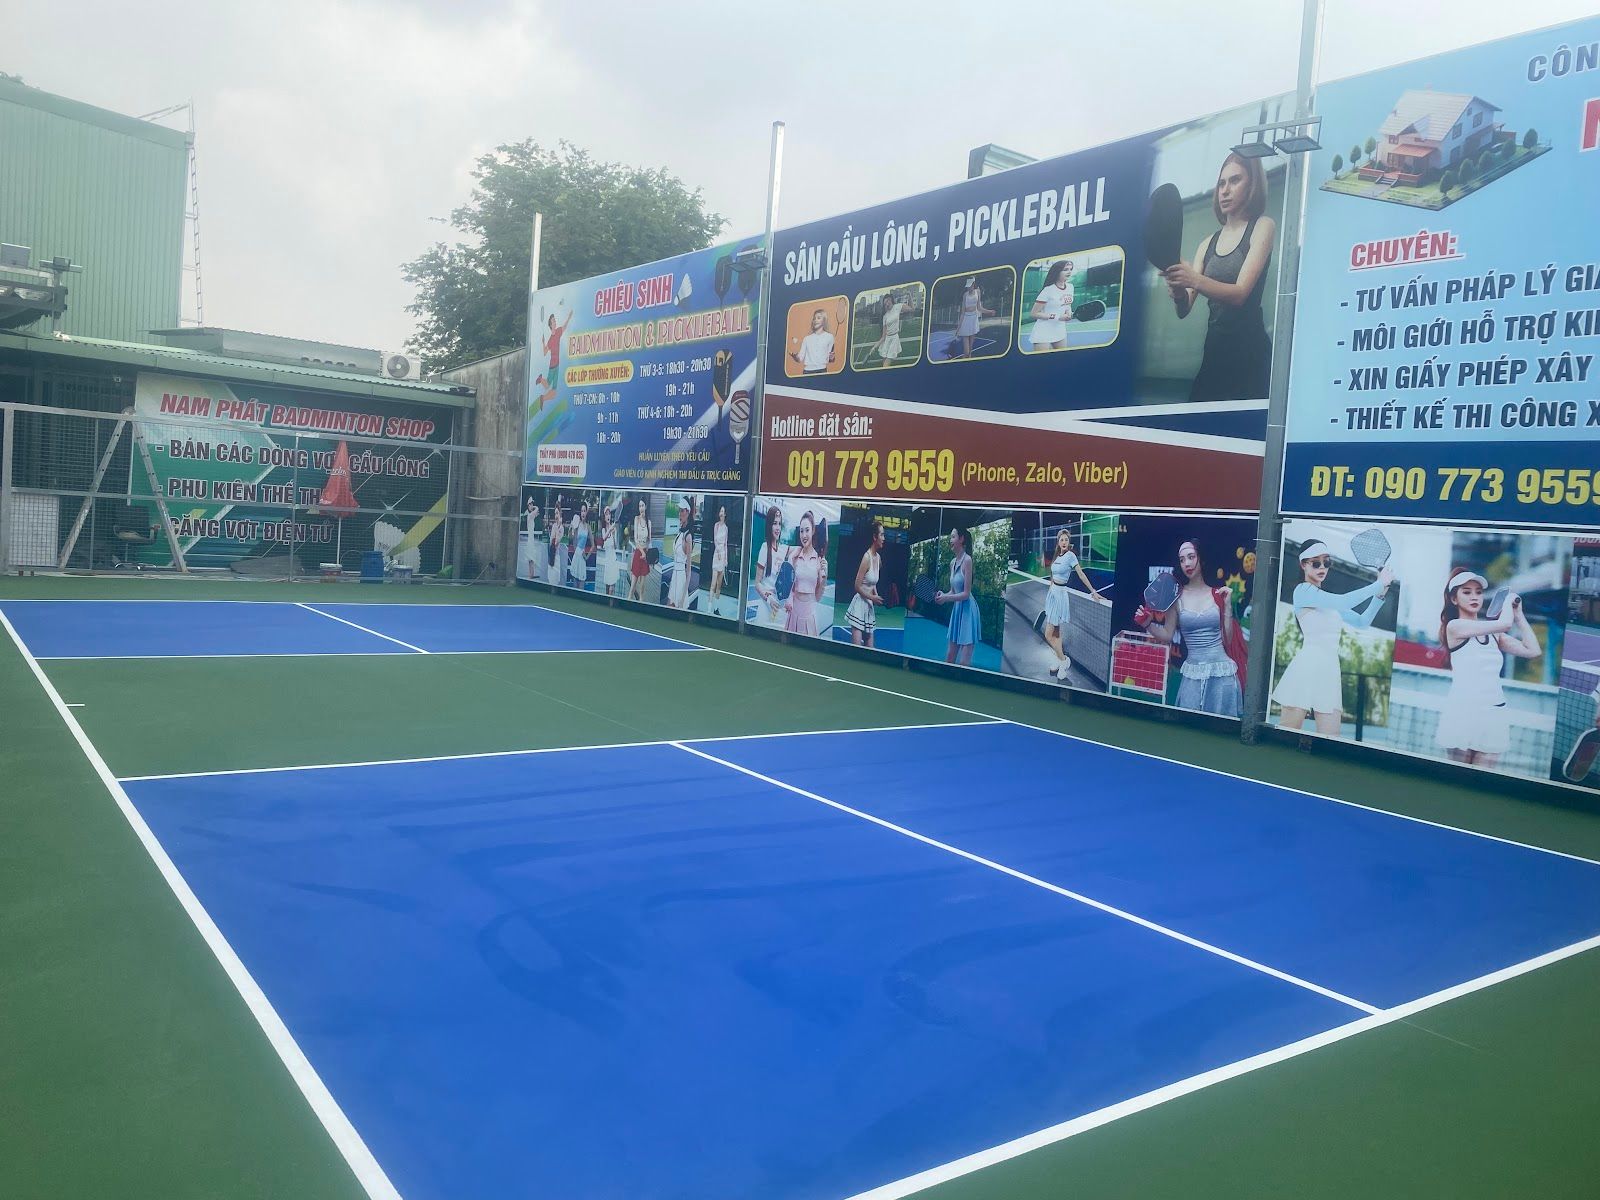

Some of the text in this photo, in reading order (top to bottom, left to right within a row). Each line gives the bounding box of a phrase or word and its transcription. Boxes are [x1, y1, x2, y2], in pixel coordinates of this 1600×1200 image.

[783, 241, 822, 286] SÂN
[826, 225, 867, 277] CẦU
[870, 219, 929, 269] LÔNG
[947, 176, 1111, 253] PICKLEBALL
[1350, 229, 1458, 269] CHUYÊN:
[593, 273, 674, 317] CHIÊU SINH
[1355, 285, 1386, 312] TƯ
[1391, 274, 1440, 308] VẤN
[1445, 269, 1516, 304] PHÁP
[1523, 263, 1558, 296] LÝ
[1564, 265, 1600, 293] GI
[567, 304, 751, 357] BADMINTON & PICKLEBALL
[1352, 322, 1397, 352] MÔI
[1403, 317, 1453, 349] GIỚI
[1460, 309, 1496, 344] HỖ
[1504, 309, 1558, 345] TRỢ
[690, 357, 712, 373] 20h30
[1347, 367, 1388, 392] XIN
[1395, 355, 1451, 389] GIẤY
[1457, 355, 1528, 387] PHÉP
[1535, 351, 1594, 384] XÂY
[665, 383, 677, 396] 19h
[682, 381, 695, 396] 21h
[159, 393, 435, 441] NAM PHÁT BADMINTON SHOP
[680, 403, 693, 418] 20h
[770, 411, 873, 441] Hotline đặt sân:
[1346, 399, 1407, 430] THIẾT
[1412, 397, 1449, 430] KẾ
[1453, 403, 1493, 429] THI
[1500, 397, 1578, 428] CÔNG
[663, 426, 682, 440] 19h30
[687, 425, 709, 440] 21h30
[169, 437, 211, 461] BÁN
[215, 441, 254, 465] CÁC
[257, 443, 309, 469] DÒNG
[312, 450, 336, 475] VỢ
[349, 448, 383, 475] CẦU
[386, 455, 430, 479] LÔNG
[787, 448, 1128, 492] 091 773 9559 (Phone, Zalo, Viber)
[1310, 465, 1355, 498] ĐT:
[1364, 465, 1427, 500] 090
[1437, 467, 1505, 503] 773
[169, 514, 335, 545] CĂNG VỢT ĐIỆN TỬ
